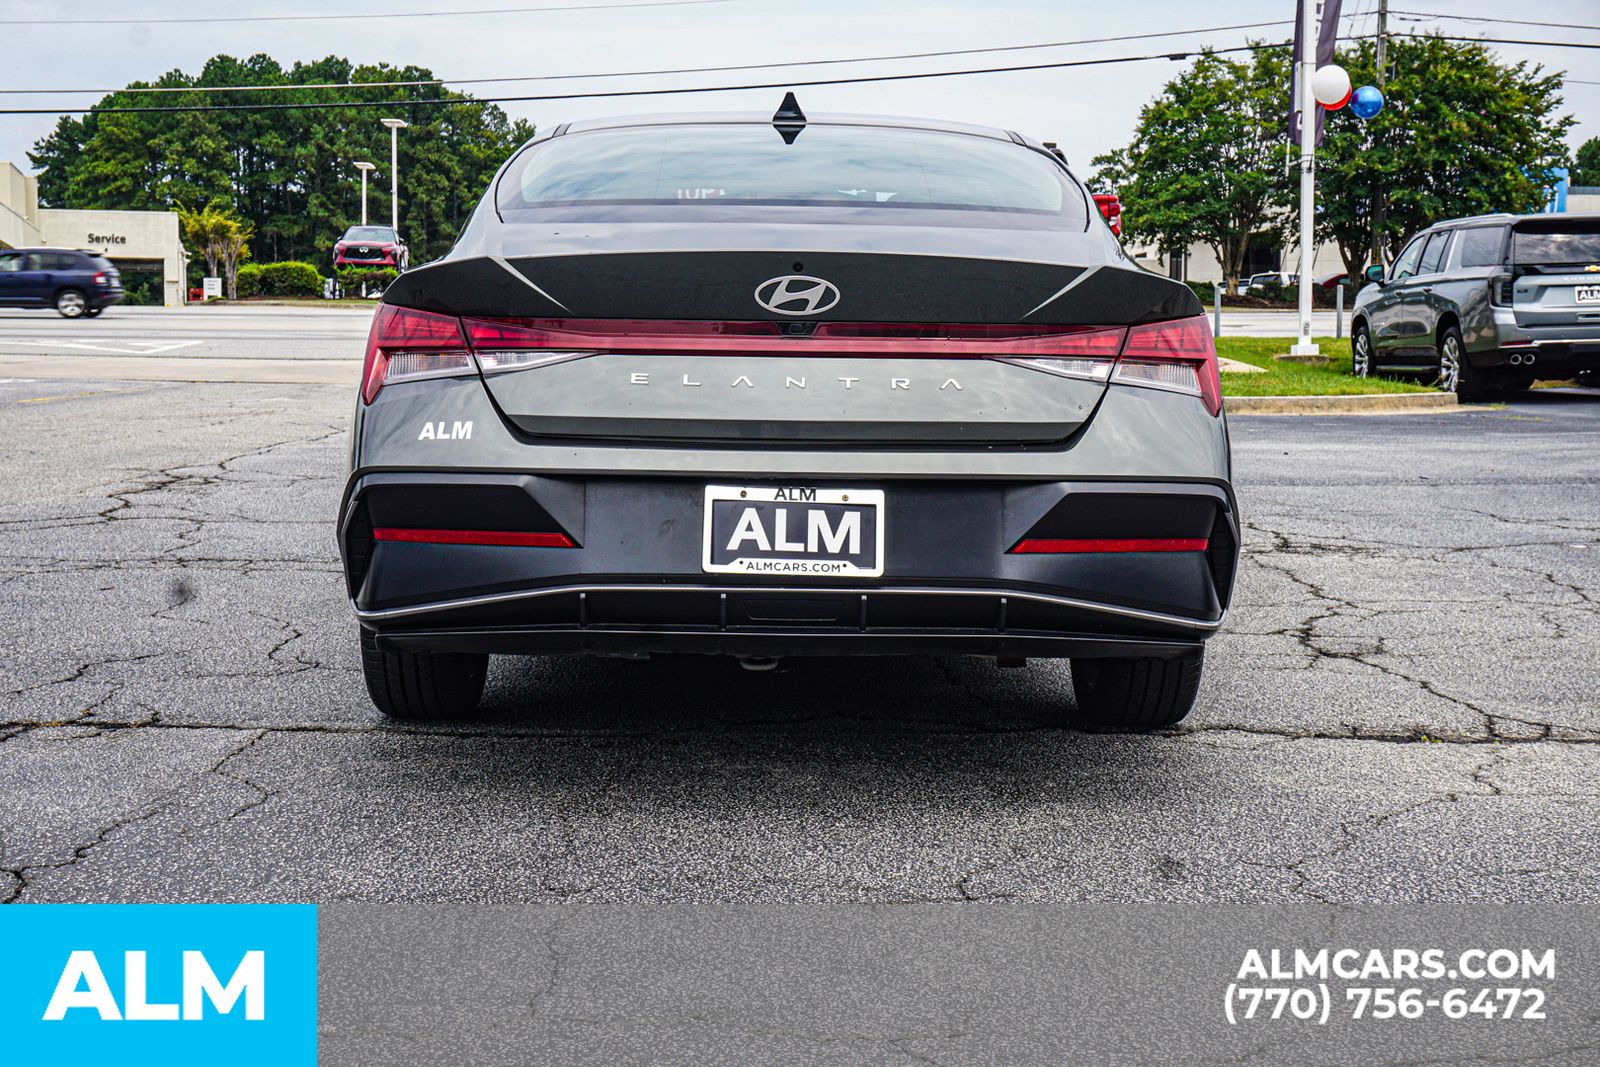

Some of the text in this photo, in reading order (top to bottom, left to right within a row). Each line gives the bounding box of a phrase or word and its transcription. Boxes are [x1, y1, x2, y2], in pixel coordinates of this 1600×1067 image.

[88, 234, 126, 244] Service
[630, 372, 963, 391] ELANTRA
[418, 421, 473, 440] ALM
[774, 487, 816, 502] ALM
[726, 507, 861, 555] ALM
[746, 562, 841, 573] ALMCARS.COM
